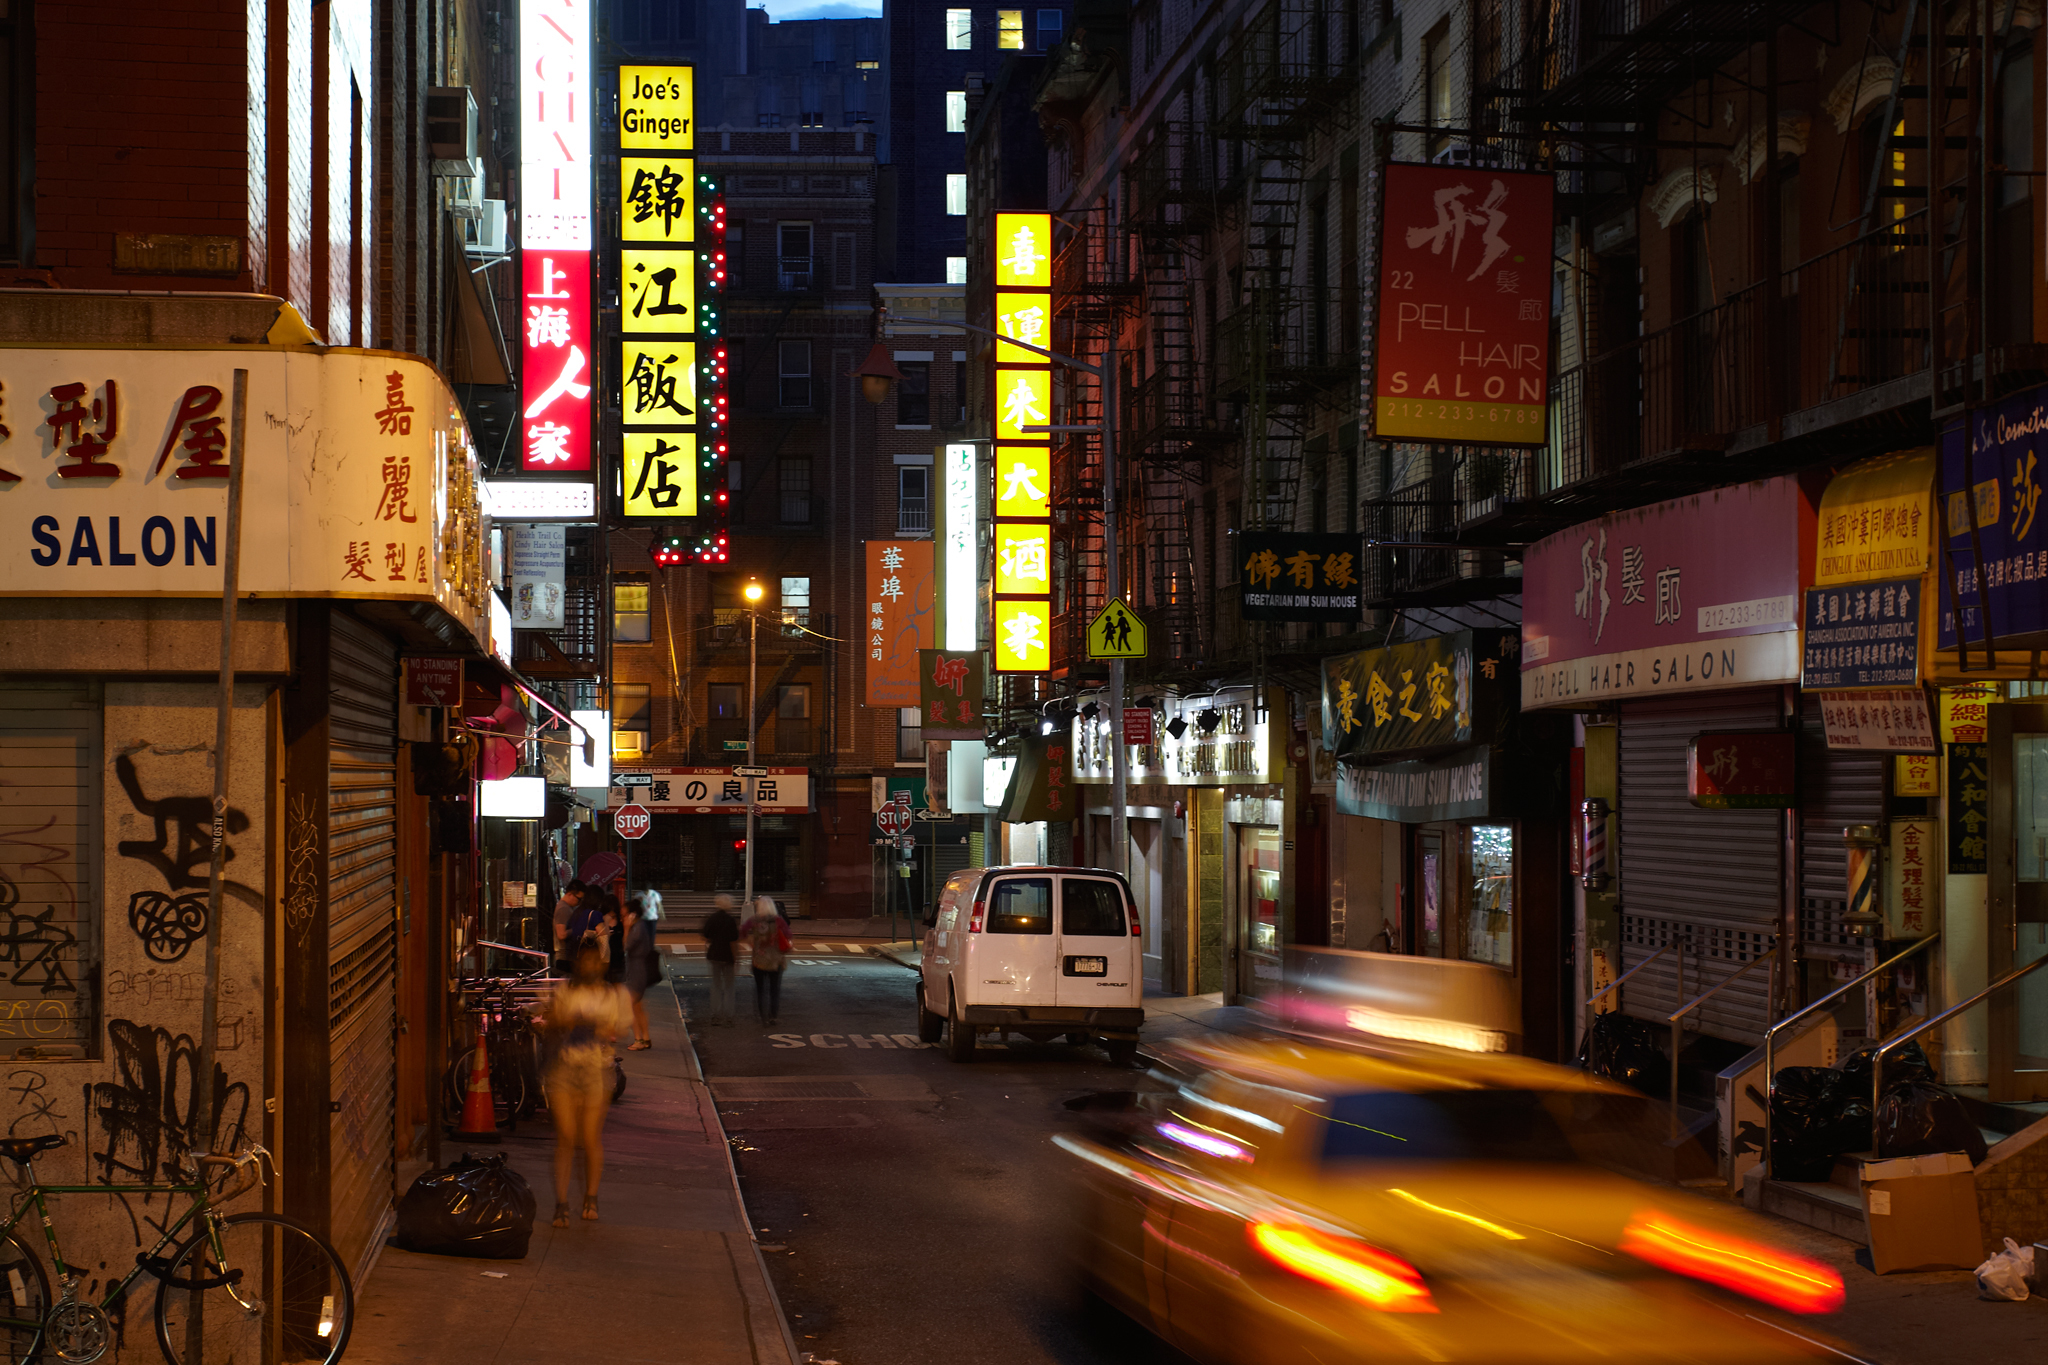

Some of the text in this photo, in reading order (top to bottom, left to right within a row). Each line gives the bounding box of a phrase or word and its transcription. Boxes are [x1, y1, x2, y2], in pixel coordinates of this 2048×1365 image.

[632, 75, 680, 99] Joe's
[622, 108, 690, 140] Ginger
[1390, 270, 1415, 290] 22
[1397, 302, 1486, 342] PELL
[624, 164, 695, 510] 錦江飯店
[524, 257, 591, 465] 上海人家
[1458, 341, 1542, 371] HAIR
[1389, 371, 1541, 401] SALON
[1387, 402, 1539, 424] 212-233-6789
[0, 379, 230, 482] 型屋
[30, 514, 217, 567] SALON
[514, 541, 531, 550] Cindy
[533, 541, 547, 549] Hair
[515, 531, 536, 540] Health
[879, 546, 905, 604] 華埠
[1244, 548, 1358, 592] 佛有緣
[1244, 593, 1357, 608] VEGETARIAN DIM SUM HOUSE
[1704, 600, 1786, 628] 212-233-6789
[870, 602, 885, 662] 眼鏡公司
[1807, 628, 1835, 645] SHANGHAI
[1835, 625, 1869, 642] ASSOCIATION
[1869, 624, 1878, 640] OF
[1877, 623, 1902, 638] AMERICA
[410, 658, 458, 671] NO STANDING
[415, 673, 453, 685] ANYTIME
[1534, 649, 1736, 700] 22 PELL HAIR SALON
[1858, 670, 1870, 682] TEL:
[1335, 661, 1452, 735] 素食之家
[648, 779, 778, 802] 優の良品
[1344, 762, 1483, 807] VEGETARIAN DIM SUM HOUSE
[1741, 785, 1785, 795] PELL
[617, 814, 648, 828] STOP
[879, 812, 910, 825] STOP
[1958, 761, 1987, 860] 八和會館
